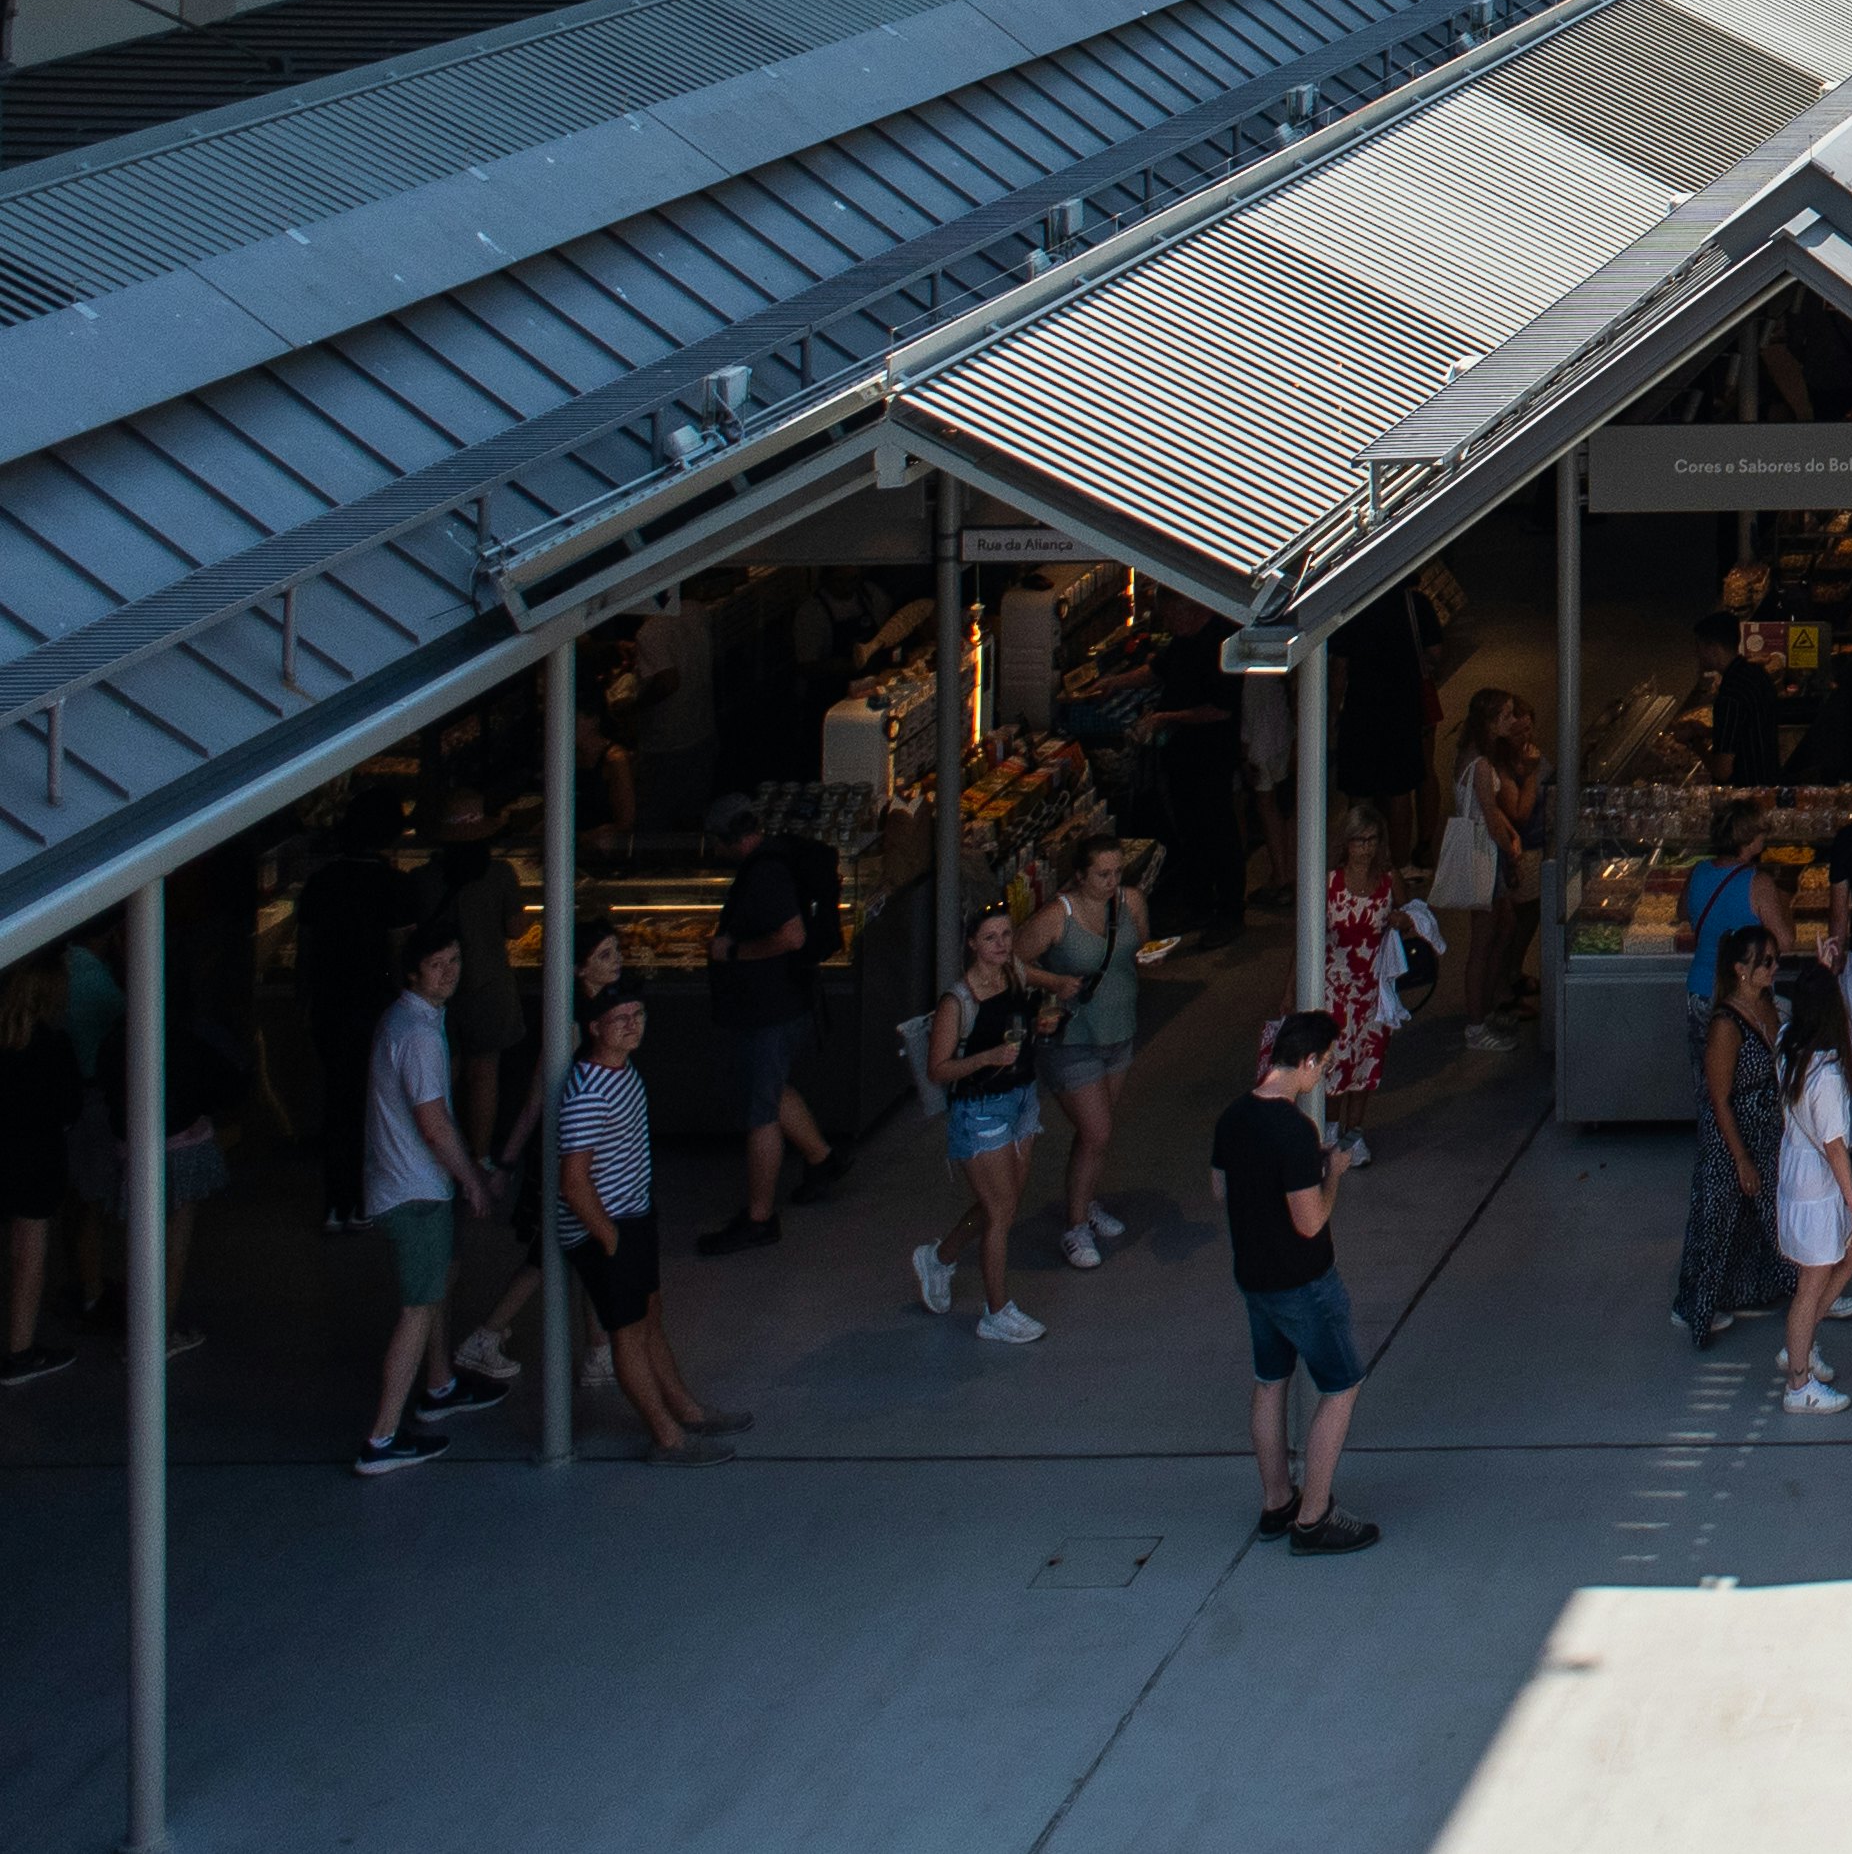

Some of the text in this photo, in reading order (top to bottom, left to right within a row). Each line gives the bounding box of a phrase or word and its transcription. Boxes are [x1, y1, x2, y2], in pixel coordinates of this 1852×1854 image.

[1674, 458, 1722, 473] Cores
[1725, 463, 1735, 473] e
[1738, 458, 1801, 473] Sabores
[1805, 458, 1825, 473] do
[977, 537, 1074, 552] Rua da Aliança
